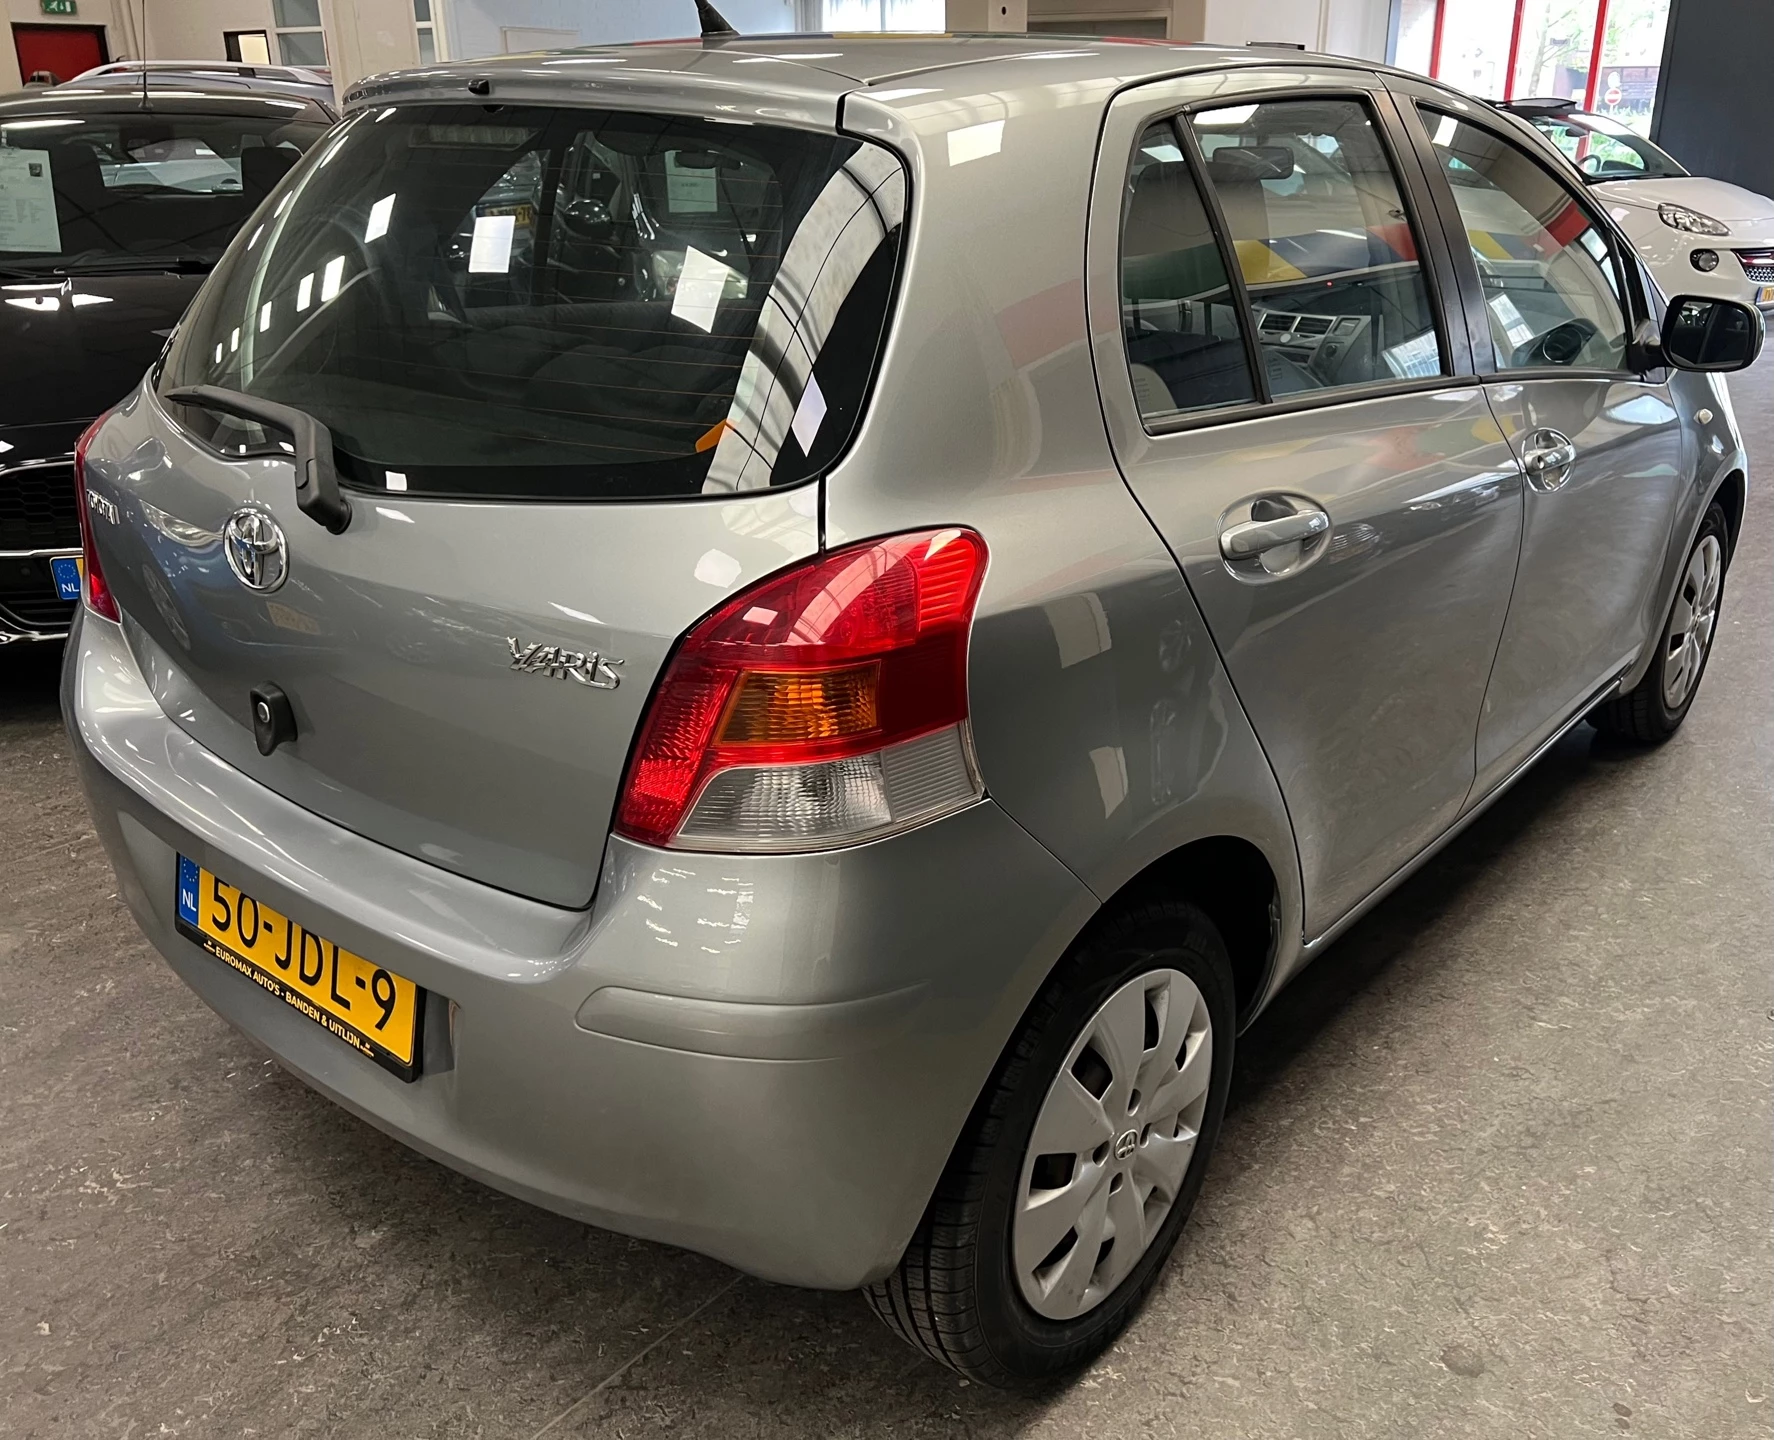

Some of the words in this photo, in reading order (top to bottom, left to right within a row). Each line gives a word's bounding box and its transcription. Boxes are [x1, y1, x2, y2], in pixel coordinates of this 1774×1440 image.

[61, 582, 80, 593] NL
[182, 888, 197, 912] NL
[212, 876, 397, 1032] 50-JDL-9
[215, 946, 252, 978] EUROMAX
[252, 970, 280, 996] AUTO'S
[285, 991, 320, 1022] BANDEN
[321, 1015, 328, 1027] &
[328, 1018, 361, 1049] UITLIJN
